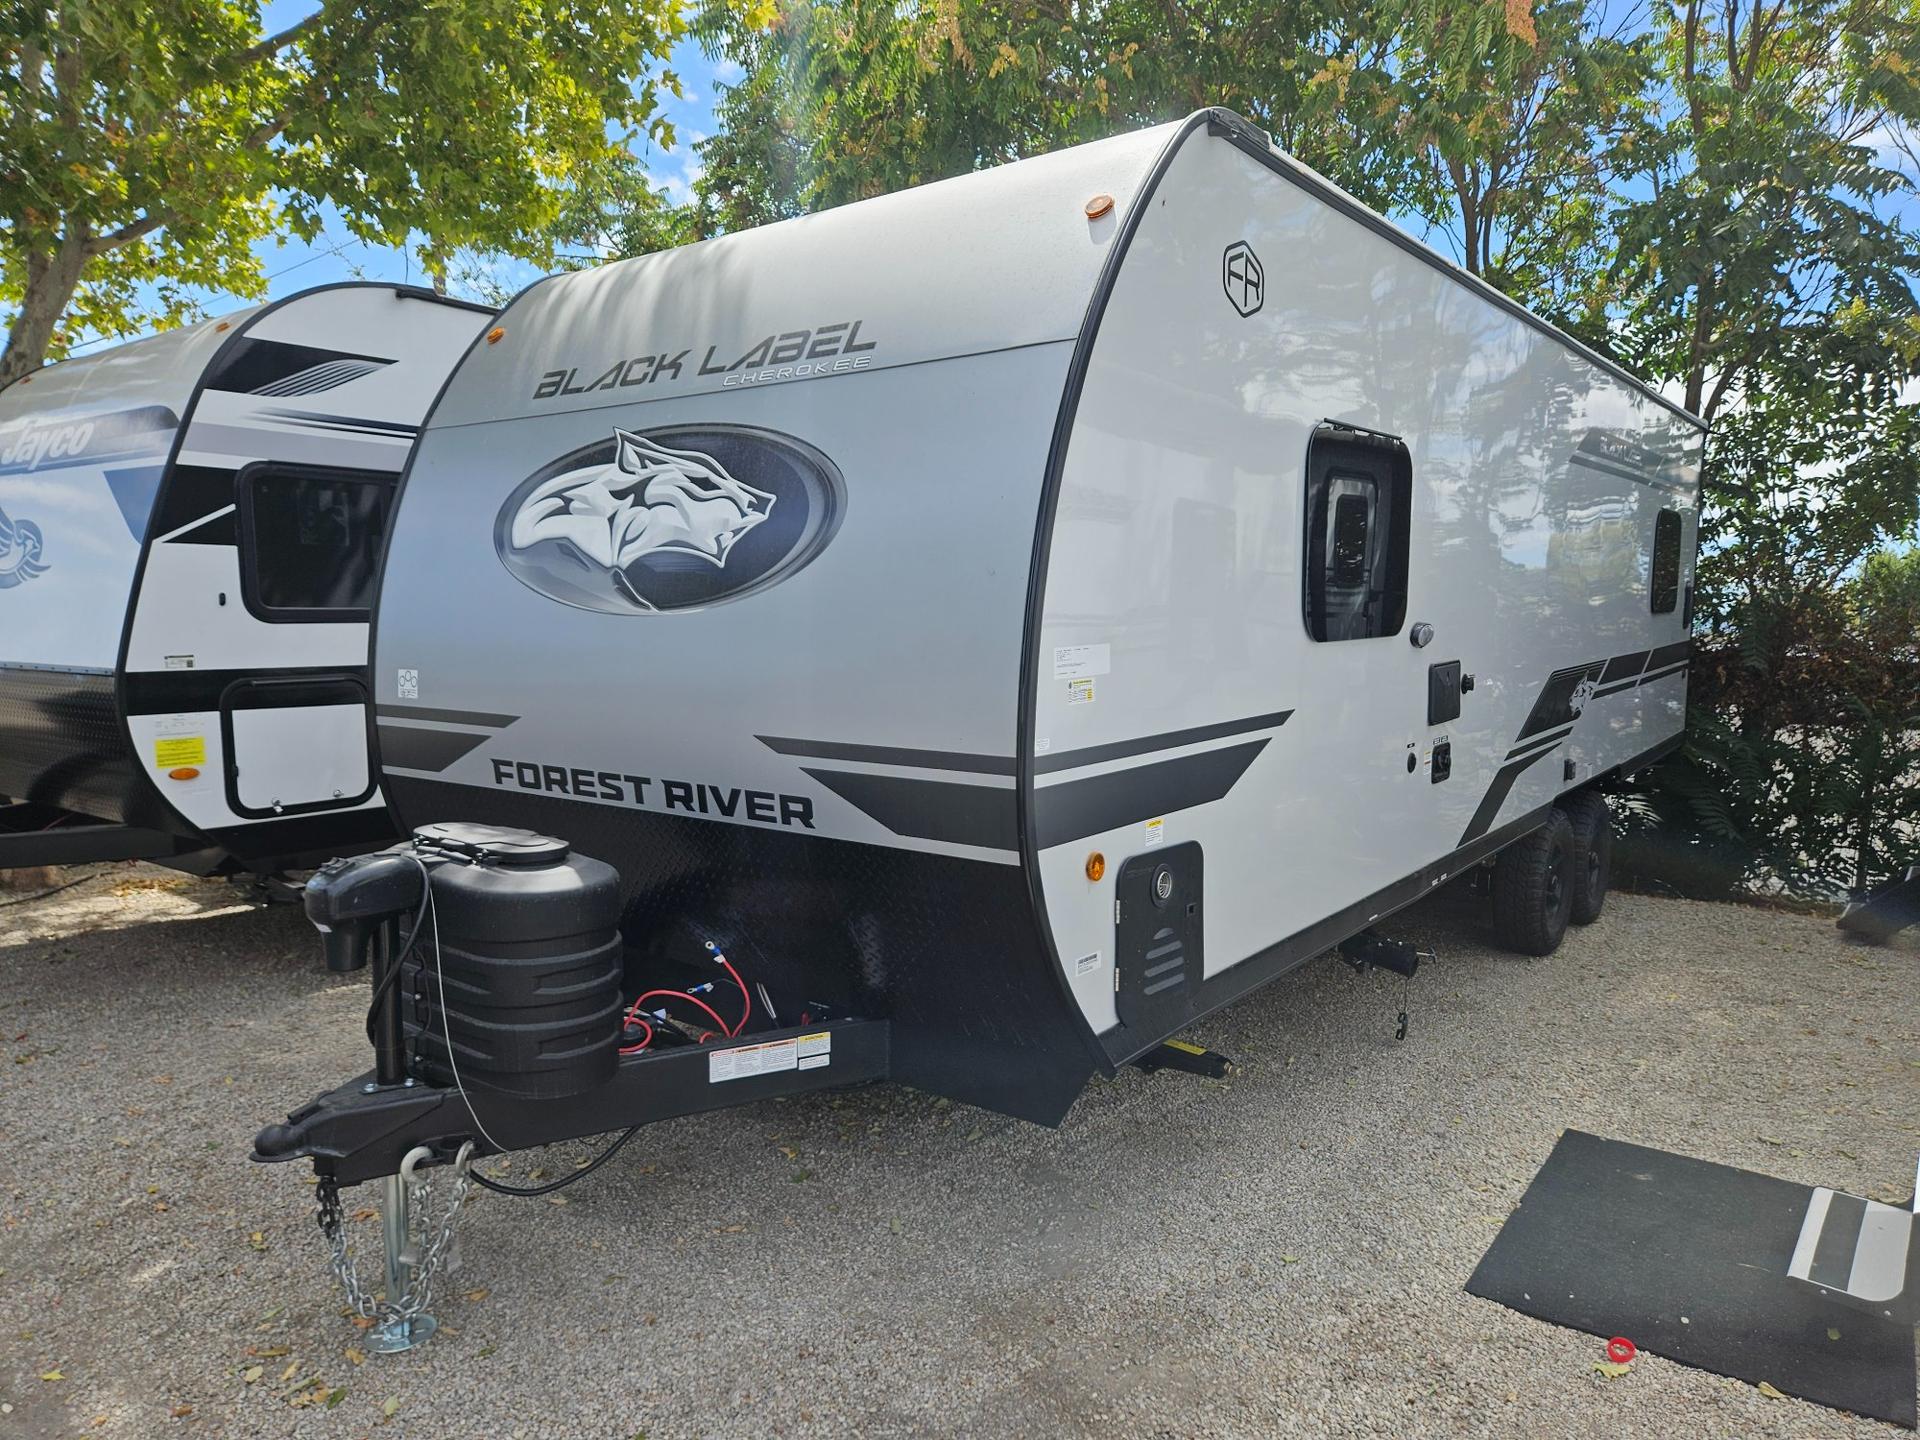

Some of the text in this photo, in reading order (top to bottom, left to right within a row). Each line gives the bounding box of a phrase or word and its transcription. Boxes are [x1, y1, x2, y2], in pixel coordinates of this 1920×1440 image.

[1228, 251, 1259, 307] FR
[533, 320, 876, 399] BLACK LABEL
[722, 355, 872, 387] CHEROKEE
[1, 419, 94, 470] Jayco
[491, 758, 814, 829] FOREST RIVER
